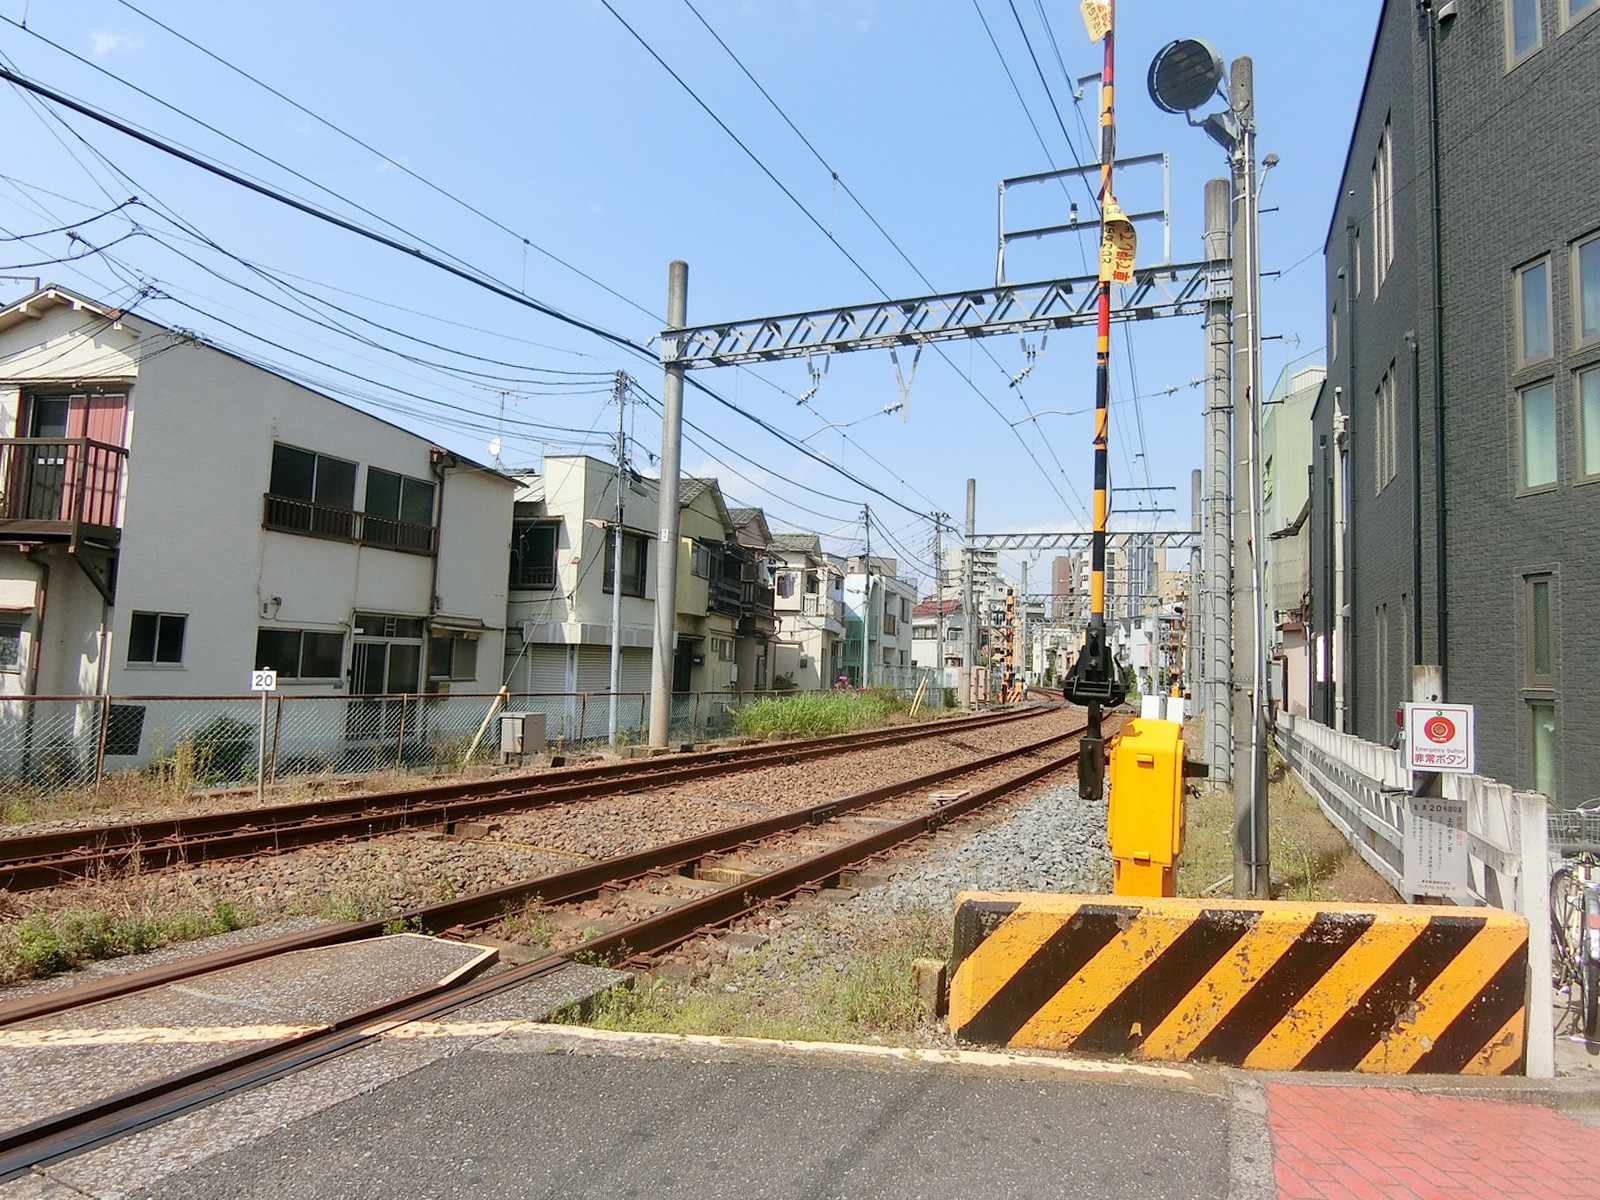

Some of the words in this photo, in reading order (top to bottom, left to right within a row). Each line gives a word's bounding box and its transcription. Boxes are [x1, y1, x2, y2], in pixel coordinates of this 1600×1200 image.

[255, 674, 273, 687] 20
[1415, 753, 1467, 765] 非常ボタン
